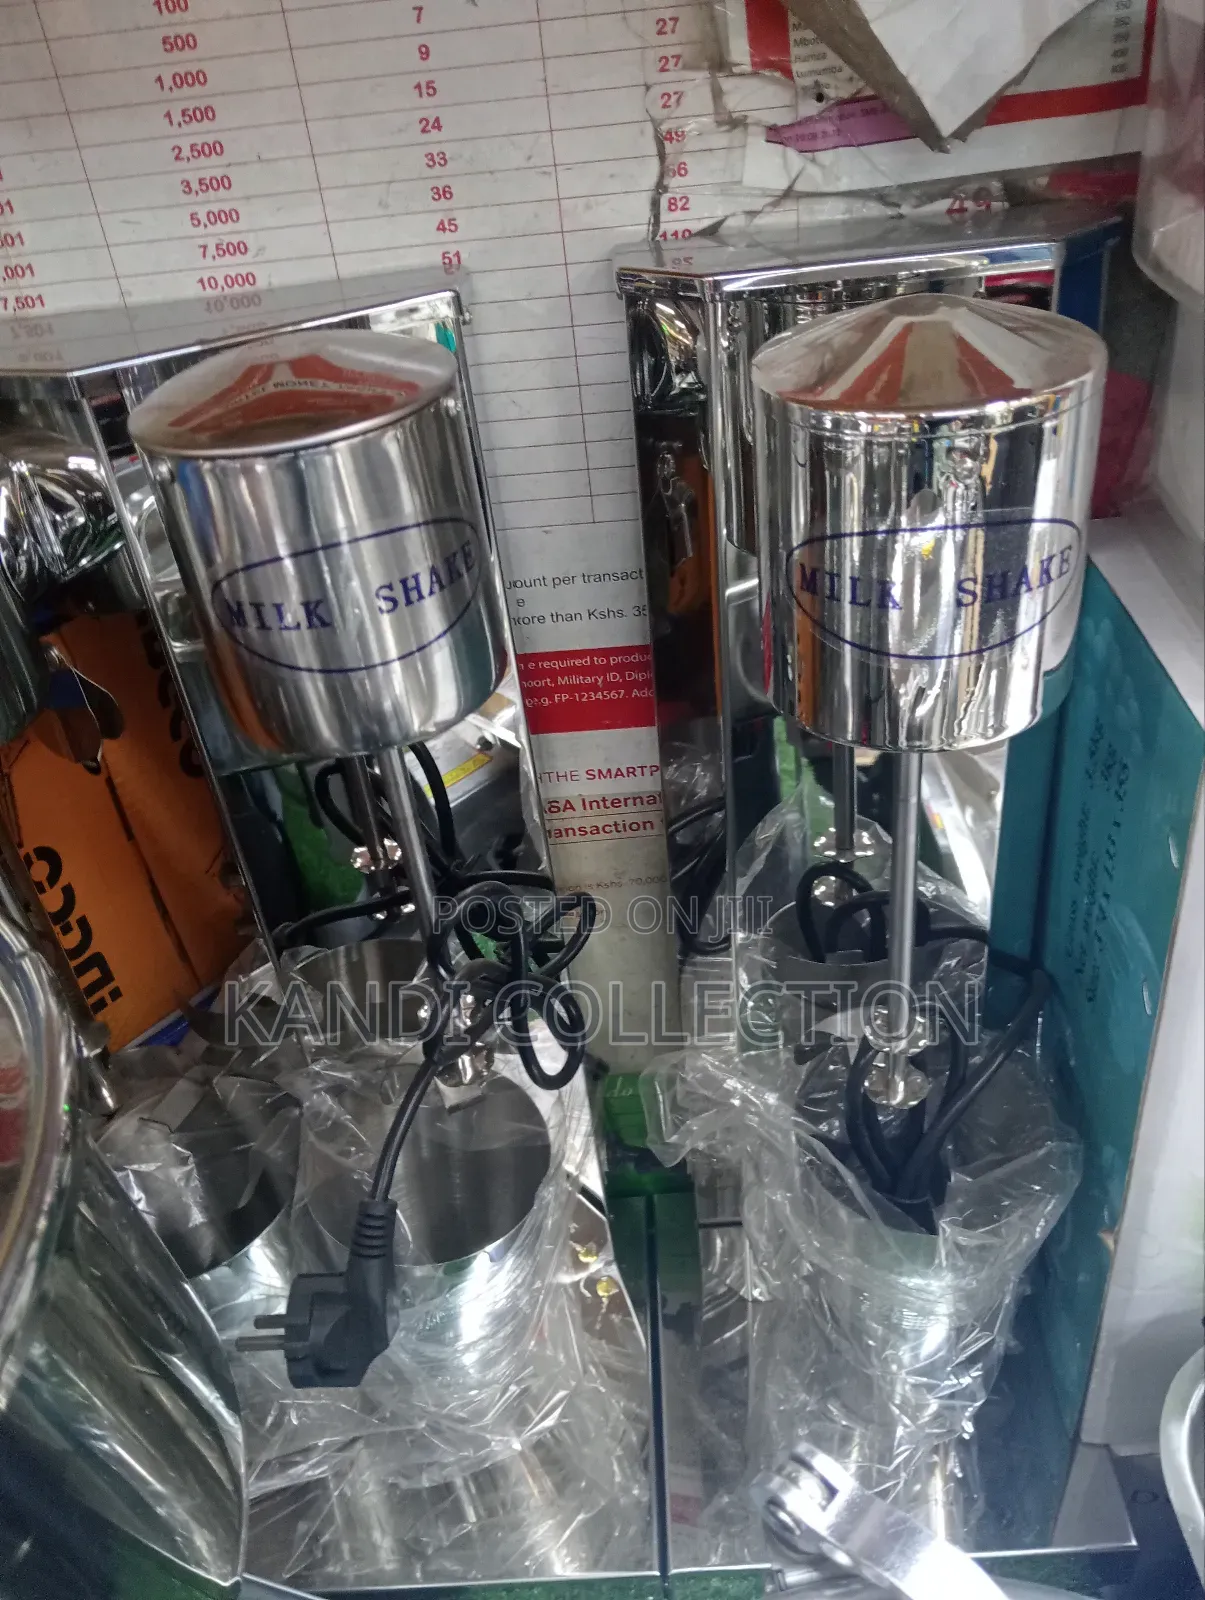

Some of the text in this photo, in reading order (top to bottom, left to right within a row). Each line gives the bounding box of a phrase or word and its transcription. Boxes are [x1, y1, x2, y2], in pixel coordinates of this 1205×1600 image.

[153, 0, 188, 15] 100
[412, 6, 423, 23] 7
[656, 17, 679, 35] 27
[162, 33, 197, 53] 500
[418, 44, 430, 60] 9
[658, 55, 682, 72] 27
[154, 69, 208, 92] 1,000
[414, 80, 437, 98] 15
[660, 91, 684, 109] 27
[164, 105, 216, 128] 1,500
[419, 116, 443, 134] 24
[171, 140, 225, 163] 2,500
[425, 151, 448, 168] 33
[181, 174, 232, 197] 3,500
[431, 185, 453, 201] 36
[667, 196, 690, 211] 82
[190, 208, 240, 229] 5,000
[436, 218, 459, 233] 45
[198, 240, 248, 261] 7,500
[442, 250, 461, 266] 51
[197, 272, 256, 292] 10,000
[226, 540, 476, 631] MILK SHAKE
[552, 575, 577, 589] per
[582, 568, 644, 584] transact
[799, 545, 1073, 610] MILK SHAKE
[550, 611, 583, 623] than
[588, 608, 627, 621] Kshs.
[539, 656, 590, 670] required
[594, 656, 607, 665] to
[558, 674, 604, 688] Military
[607, 671, 622, 682] ID,
[555, 690, 629, 704] FP-1234567.
[585, 764, 660, 780] SMARTP
